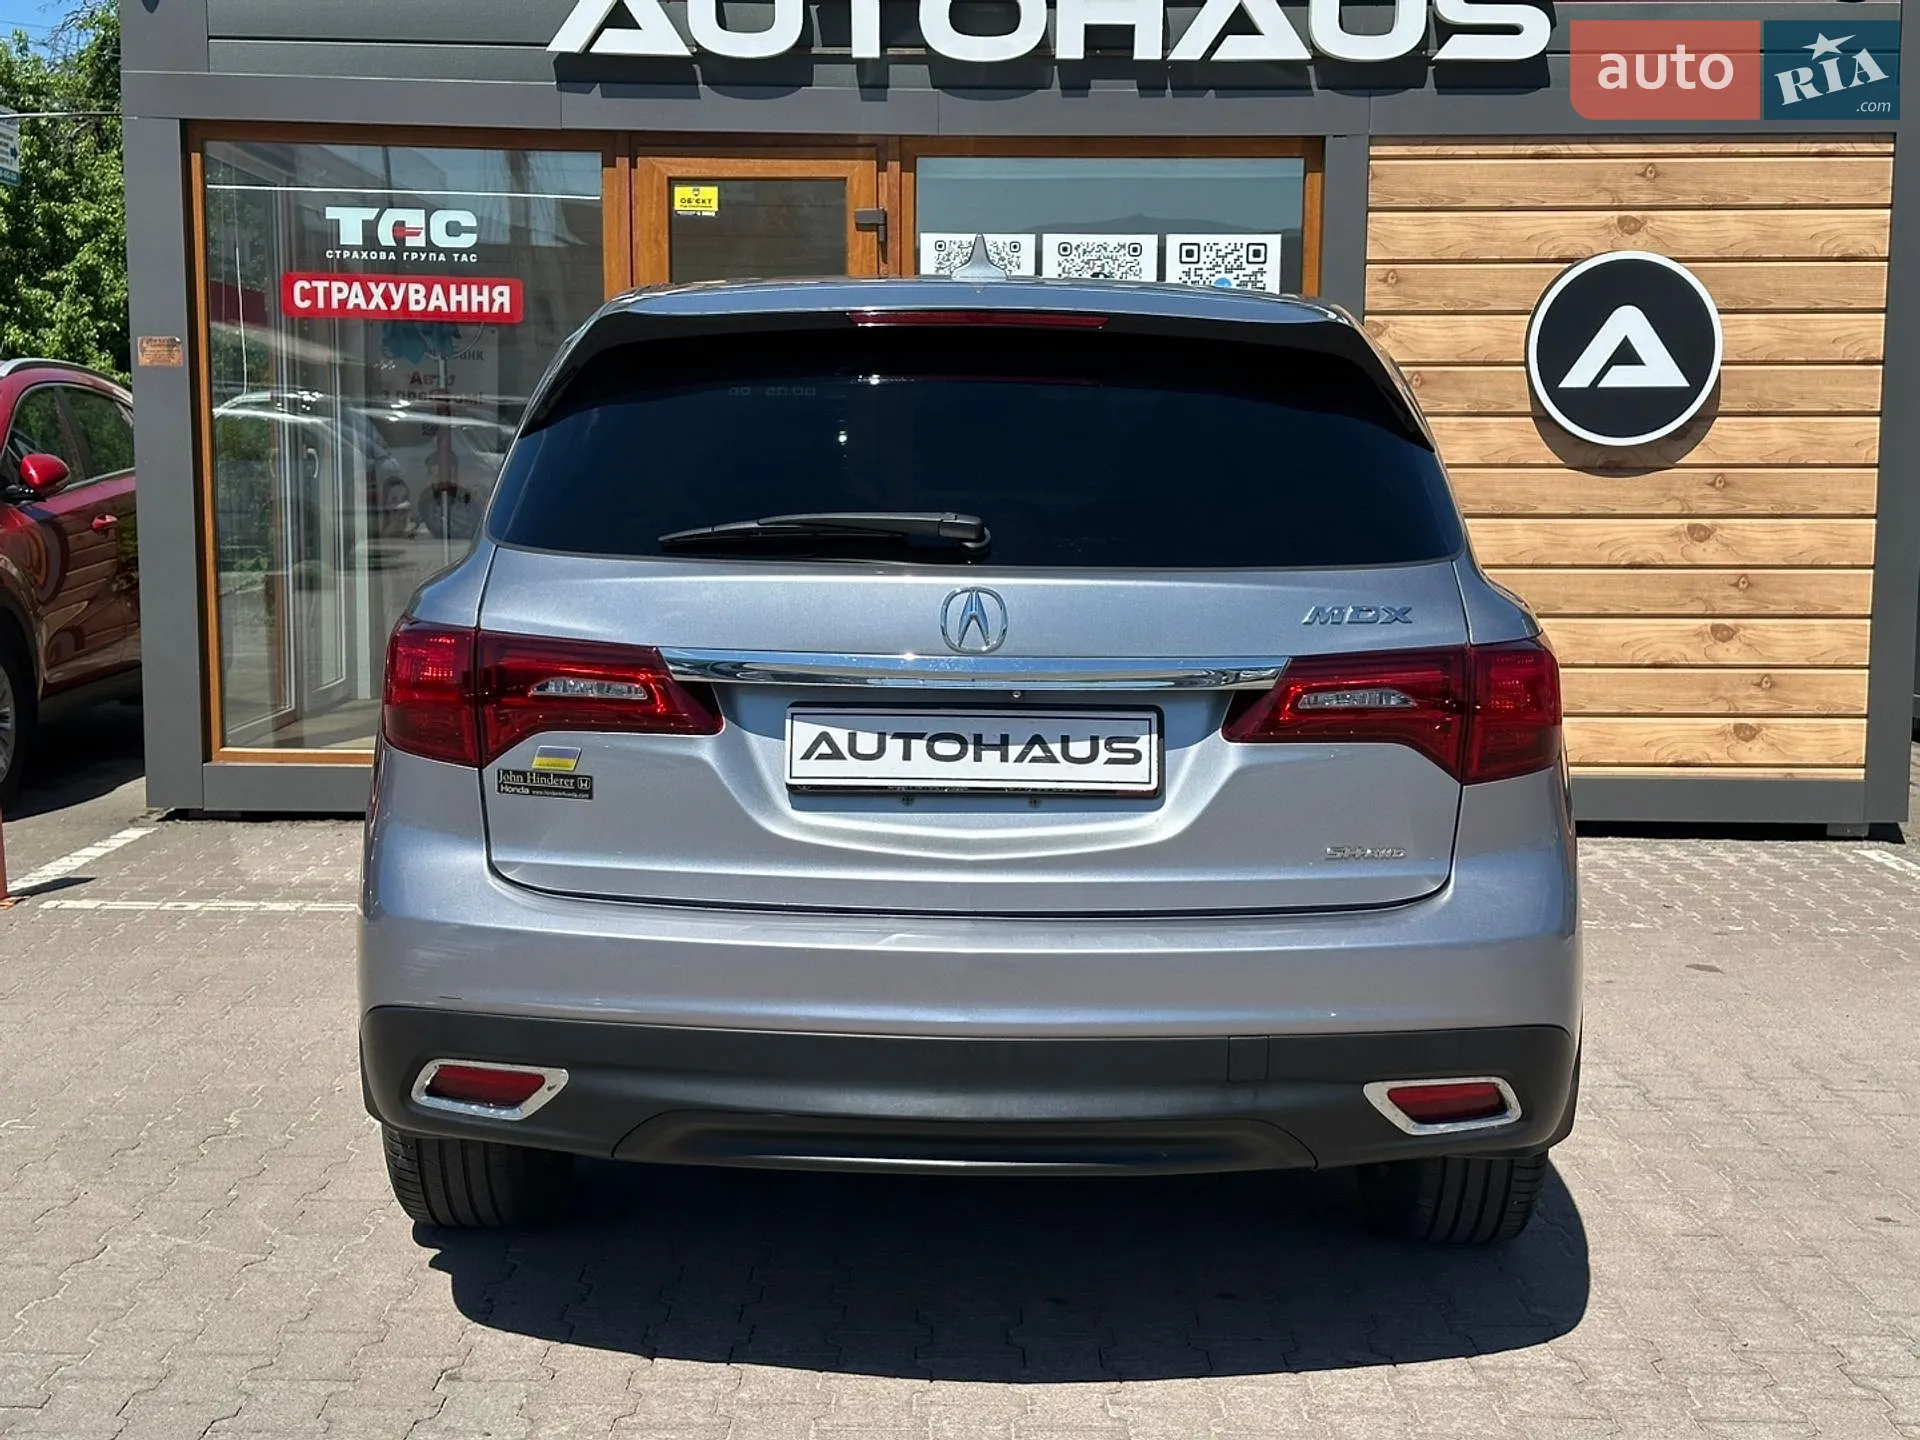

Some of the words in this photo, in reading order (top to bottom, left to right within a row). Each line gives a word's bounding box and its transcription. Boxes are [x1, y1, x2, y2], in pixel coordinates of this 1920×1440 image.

[547, 0, 1552, 62] AUTOHAUS
[325, 249, 397, 261] СТРАХОВА
[403, 252, 446, 262] ГРУПА
[453, 253, 478, 263] ТАС
[292, 280, 512, 314] СТРАХУВАННЯ
[1301, 605, 1413, 626] MDX
[800, 730, 1143, 766] AUTOHAUS
[498, 769, 524, 783] John
[526, 771, 575, 788] Hinderer
[500, 784, 530, 794] Honda
